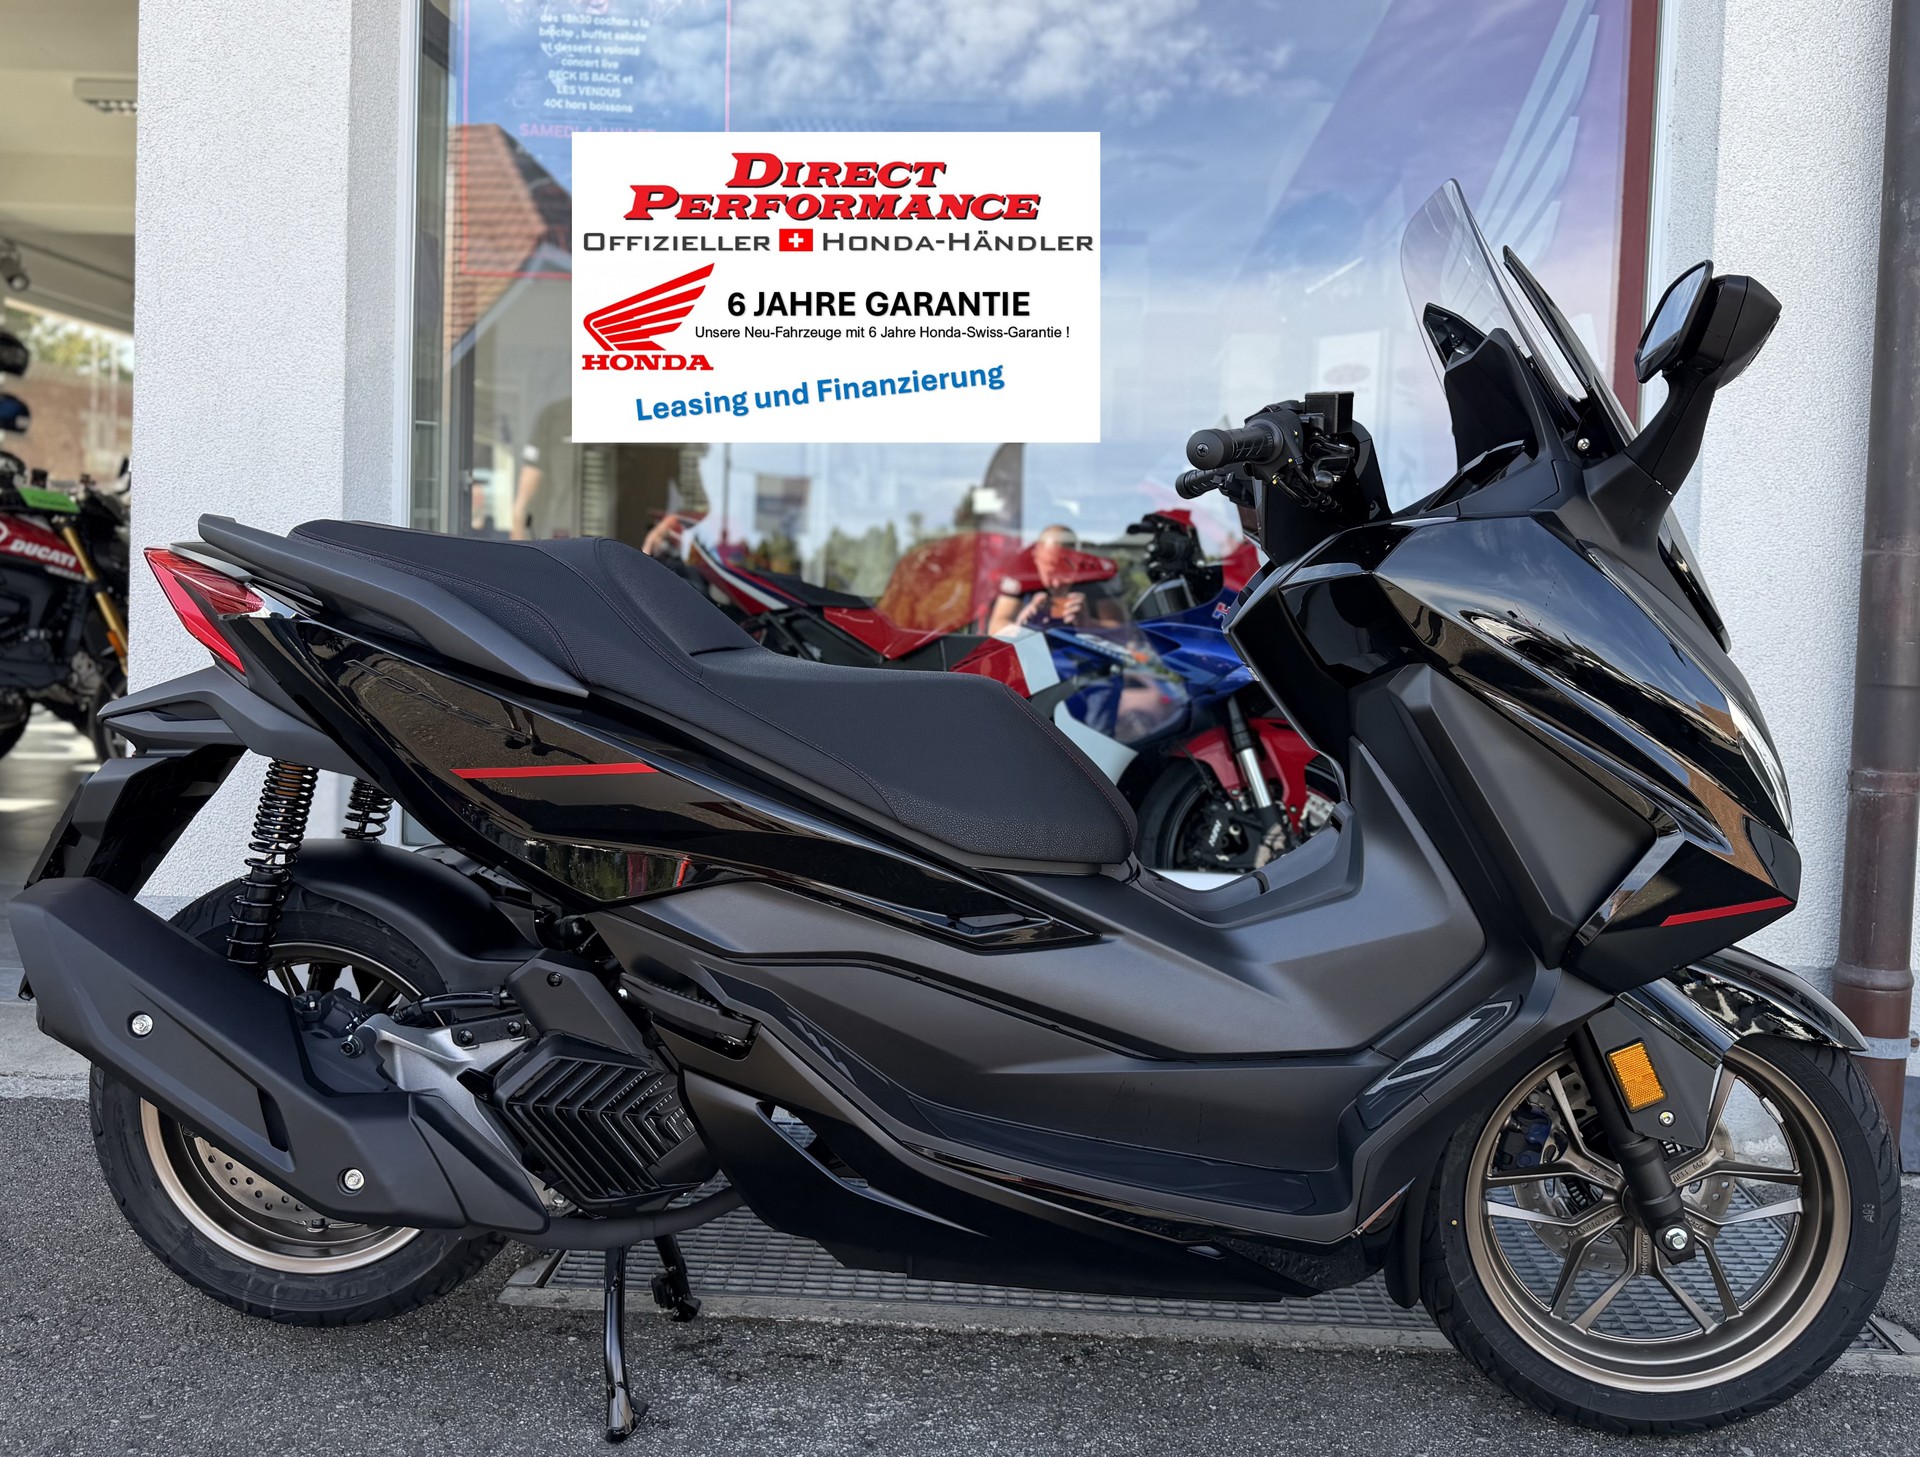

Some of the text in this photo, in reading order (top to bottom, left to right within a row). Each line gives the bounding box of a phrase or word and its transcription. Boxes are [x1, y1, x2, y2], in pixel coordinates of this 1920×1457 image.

[561, 13, 591, 25] 18h30
[593, 15, 630, 27] cochon
[640, 18, 650, 28] la
[581, 29, 612, 40] buffet
[614, 31, 647, 42] salade
[540, 42, 553, 52] et
[554, 42, 592, 53] dessert
[561, 57, 620, 70] concert live
[548, 69, 634, 85] BECK IS BACK et
[556, 85, 622, 98] LES VENDUS
[543, 98, 635, 113] 40€ hors boissons
[9, 538, 77, 568] DUCATI
